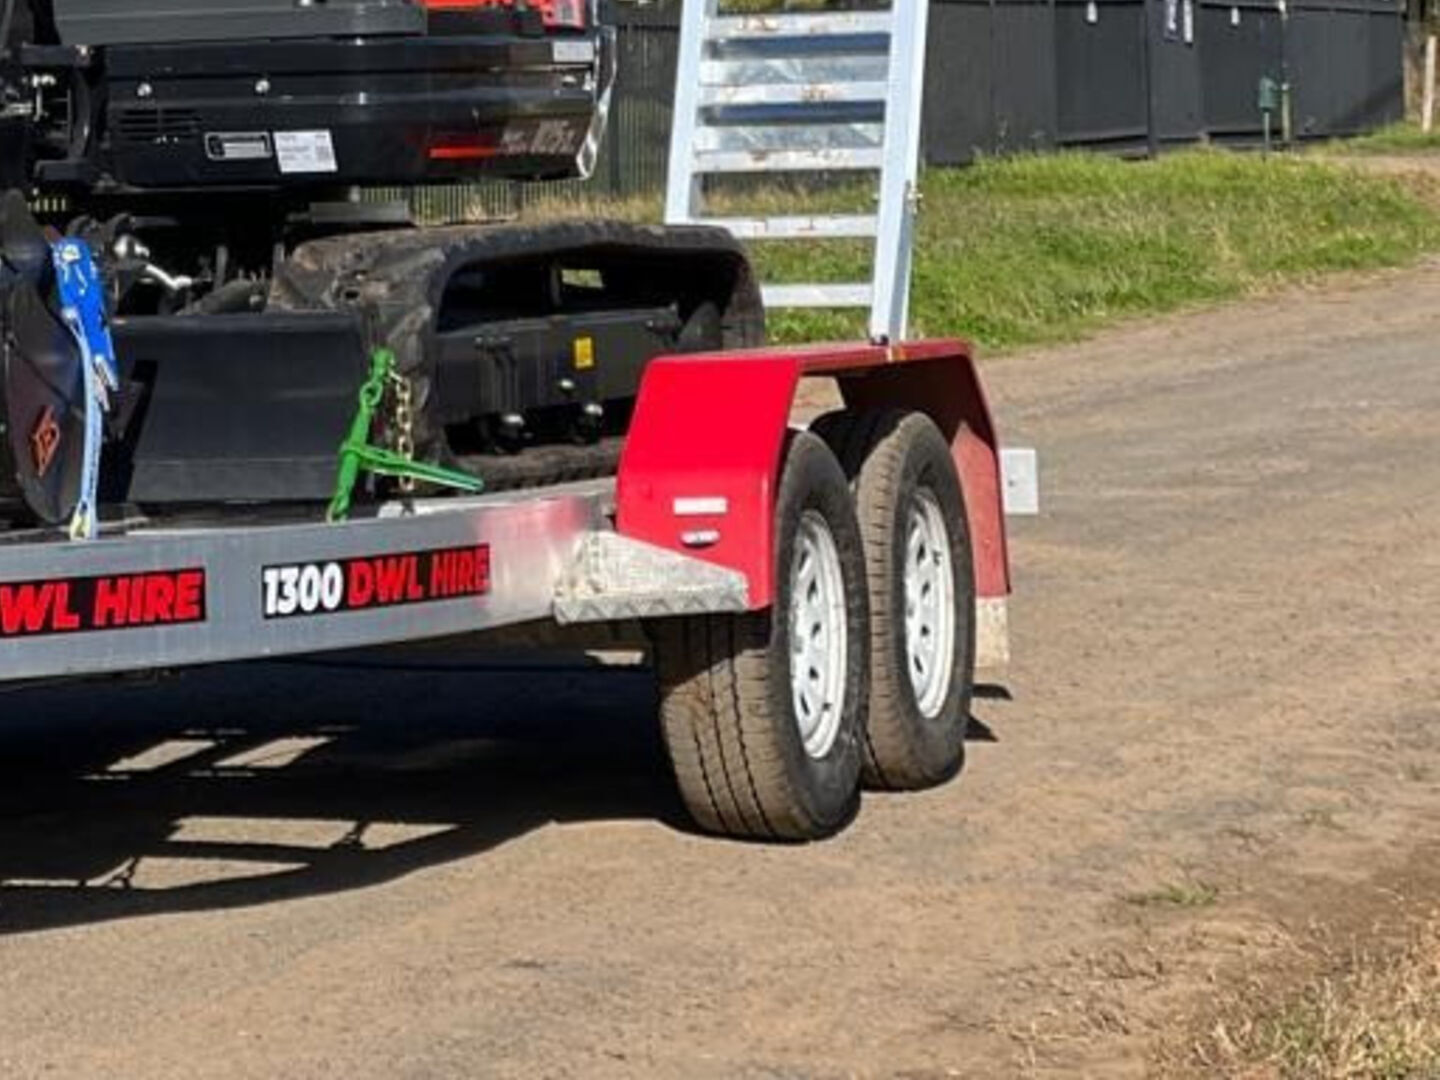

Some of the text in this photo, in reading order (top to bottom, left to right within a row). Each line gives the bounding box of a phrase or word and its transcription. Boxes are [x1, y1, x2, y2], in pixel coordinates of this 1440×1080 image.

[94, 571, 205, 627] HIRE
[264, 545, 490, 615] 1300 DWL HIRE
